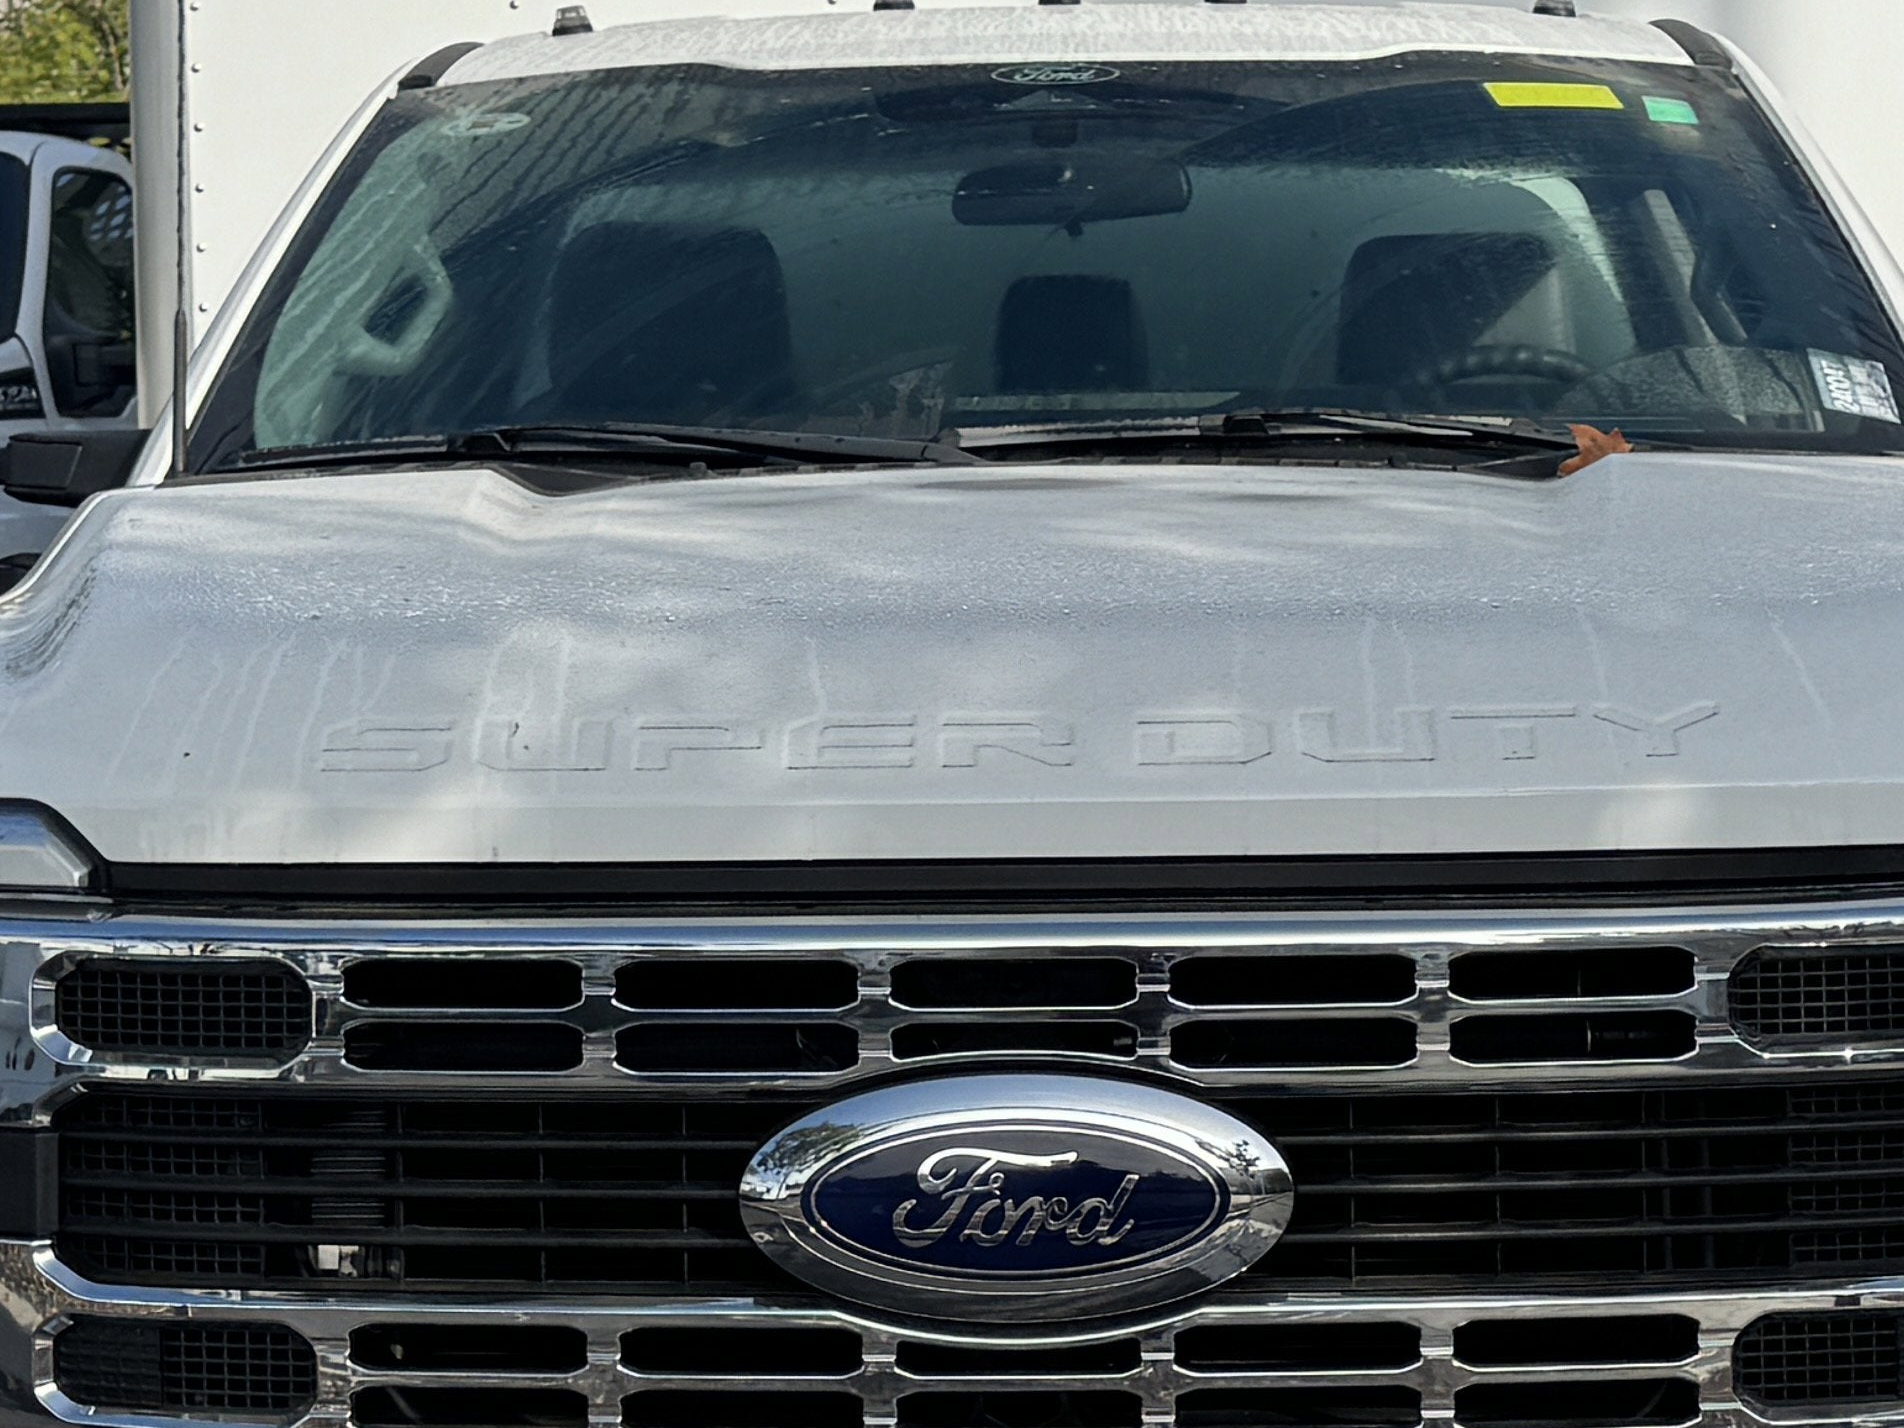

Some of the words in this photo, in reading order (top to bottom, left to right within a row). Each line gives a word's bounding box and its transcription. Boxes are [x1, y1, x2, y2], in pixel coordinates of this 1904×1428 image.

[1013, 66, 1096, 82] Ford
[319, 710, 1073, 772] SUPER
[1135, 701, 1720, 766] DUTY
[892, 1147, 1141, 1248] Ford
